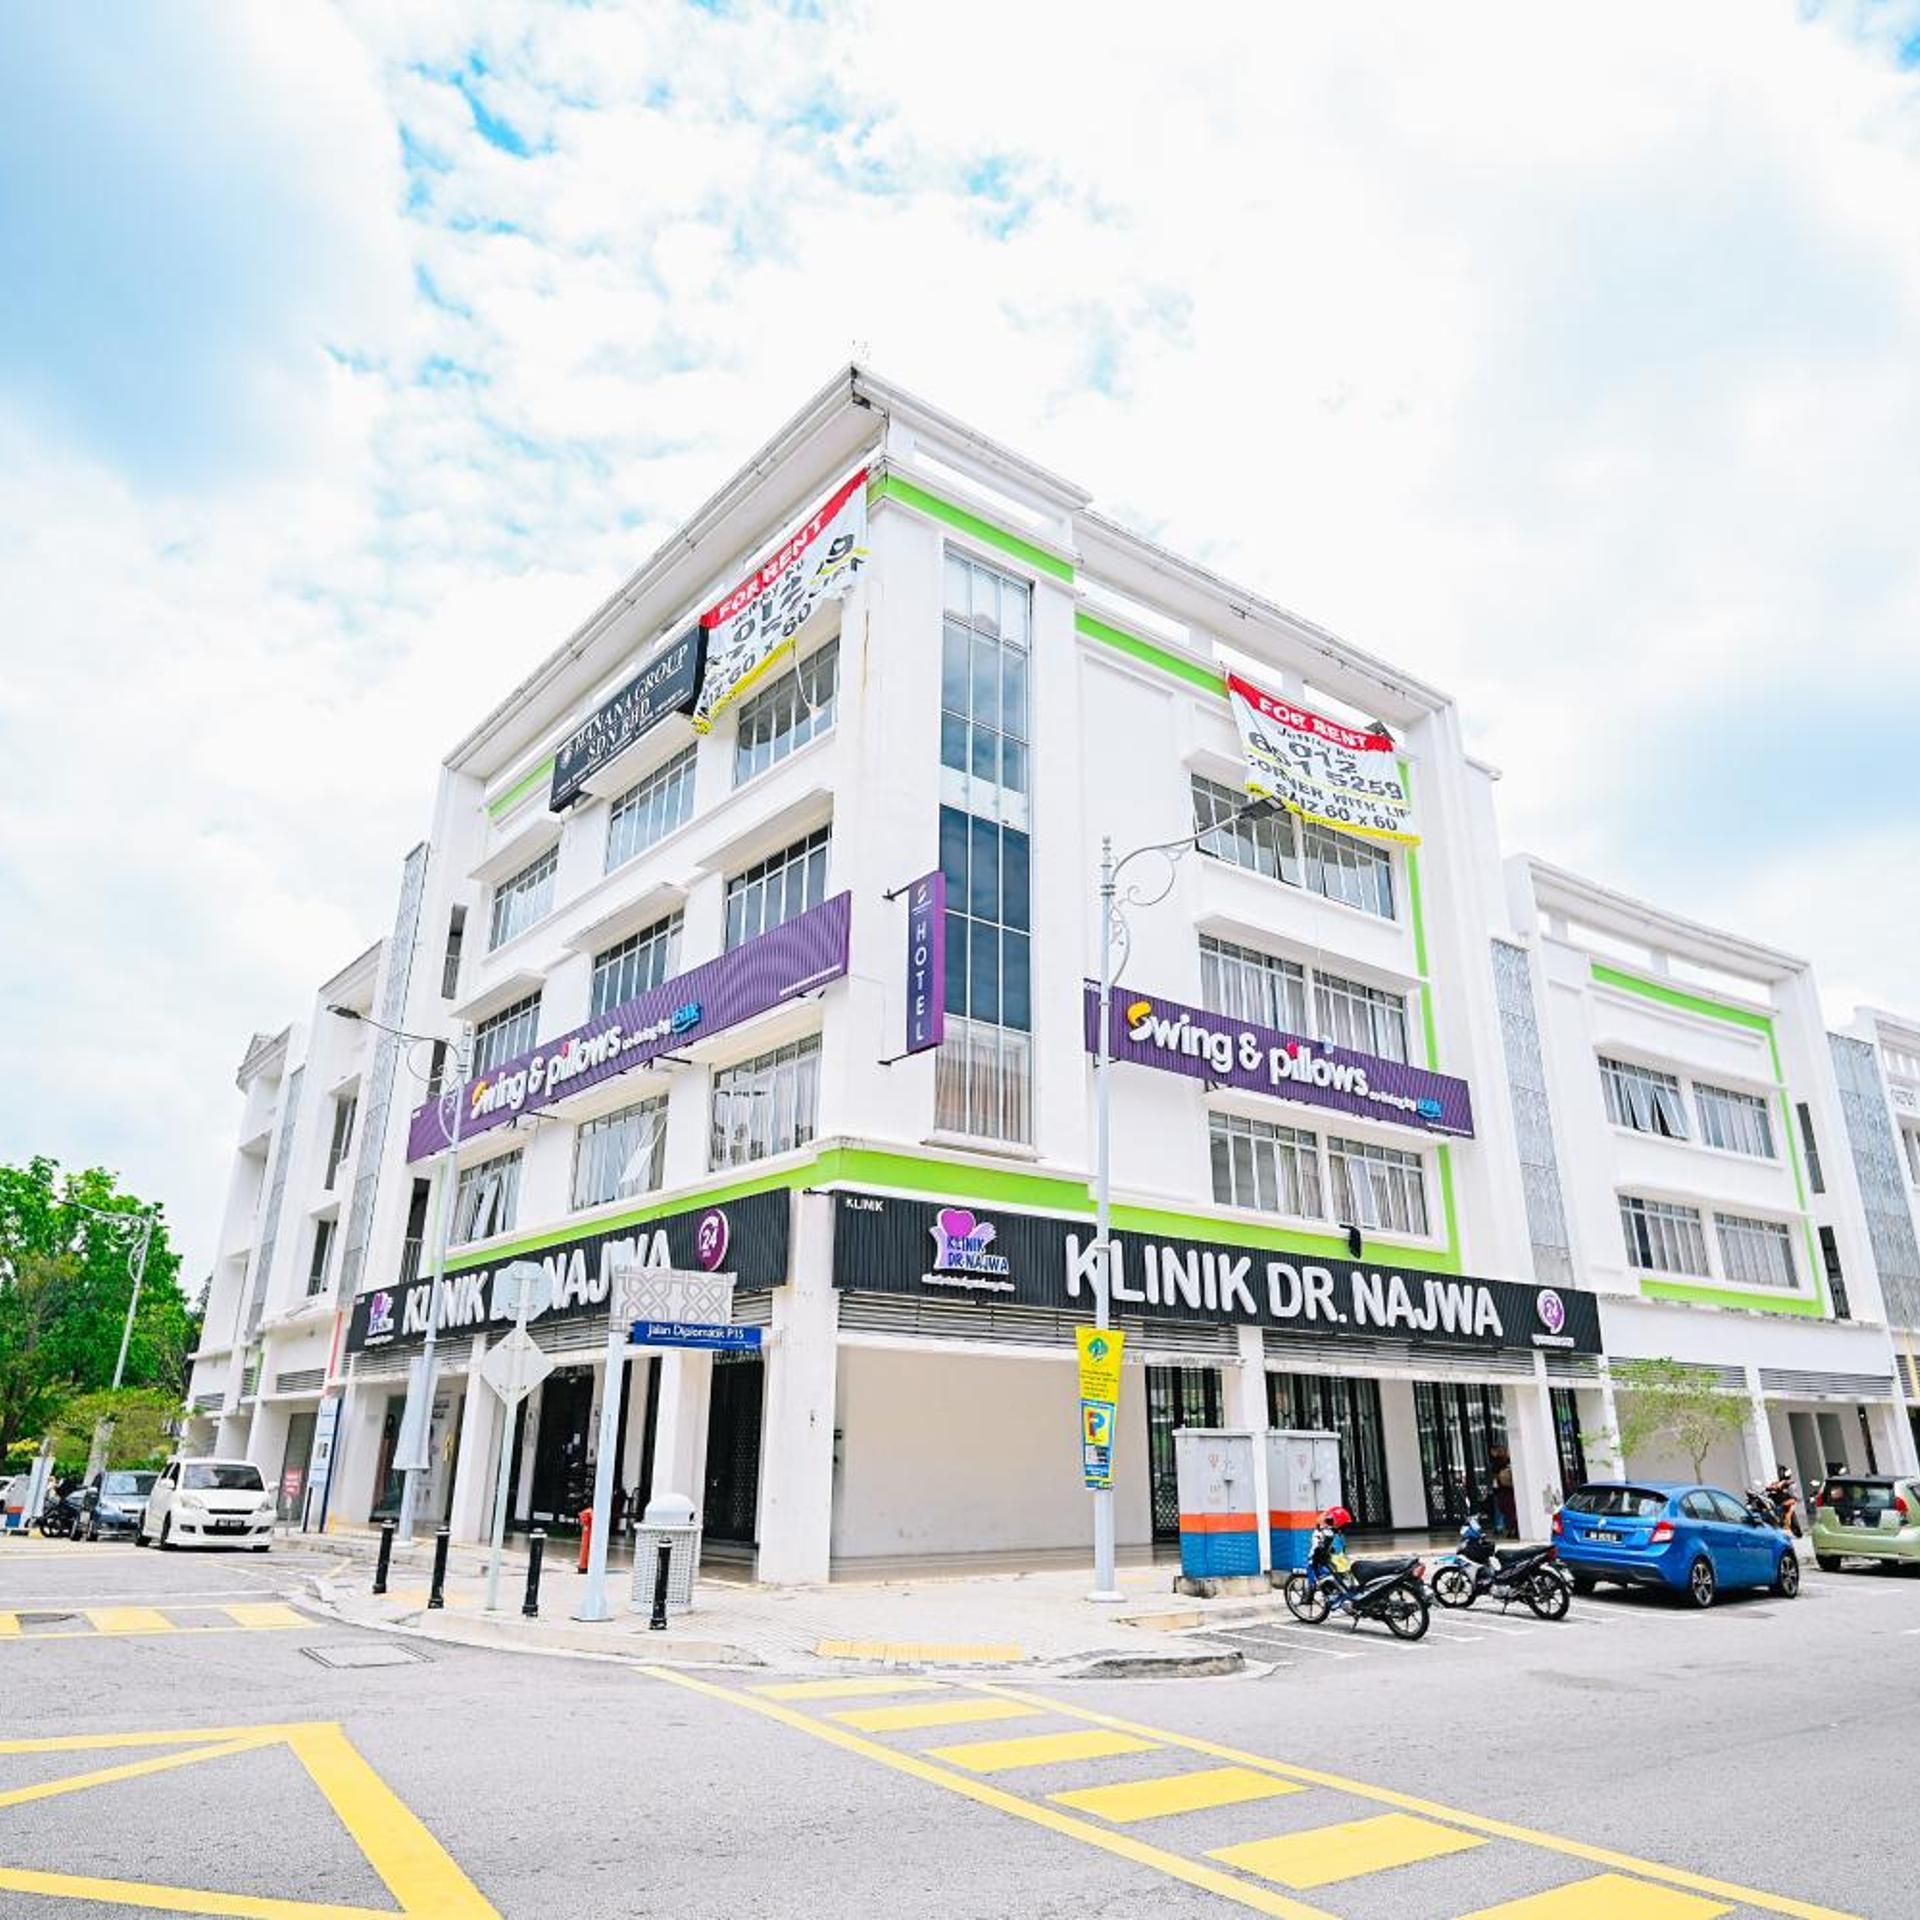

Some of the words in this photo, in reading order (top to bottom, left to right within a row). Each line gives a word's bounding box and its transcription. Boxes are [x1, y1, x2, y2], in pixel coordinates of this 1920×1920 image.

[718, 582, 760, 619] FOR
[763, 511, 825, 584] RENT
[635, 643, 689, 701] GROUP
[1259, 698, 1306, 729] FOR
[1313, 718, 1368, 748] RENT
[1325, 804, 1351, 822] 60
[1373, 815, 1398, 831] 60
[915, 920, 927, 1041] HOTEL
[471, 1071, 528, 1120] Swing
[528, 1056, 546, 1094] &
[545, 1025, 622, 1097] pillows
[1126, 1001, 1233, 1074] Swing
[1238, 1031, 1263, 1071] &
[1269, 1040, 1369, 1097] pillows
[845, 1198, 884, 1212] KLINIK
[702, 1229, 717, 1249] 24
[946, 1235, 984, 1252] KLINIK
[402, 1271, 489, 1336] KLINIK
[1066, 1234, 1257, 1315] KLINIK
[1267, 1262, 1347, 1323] DR.
[1353, 1271, 1504, 1338] NAJWA
[647, 1323, 671, 1337] Jalan
[673, 1325, 725, 1339] Diplomatik
[726, 1328, 745, 1340] P15
